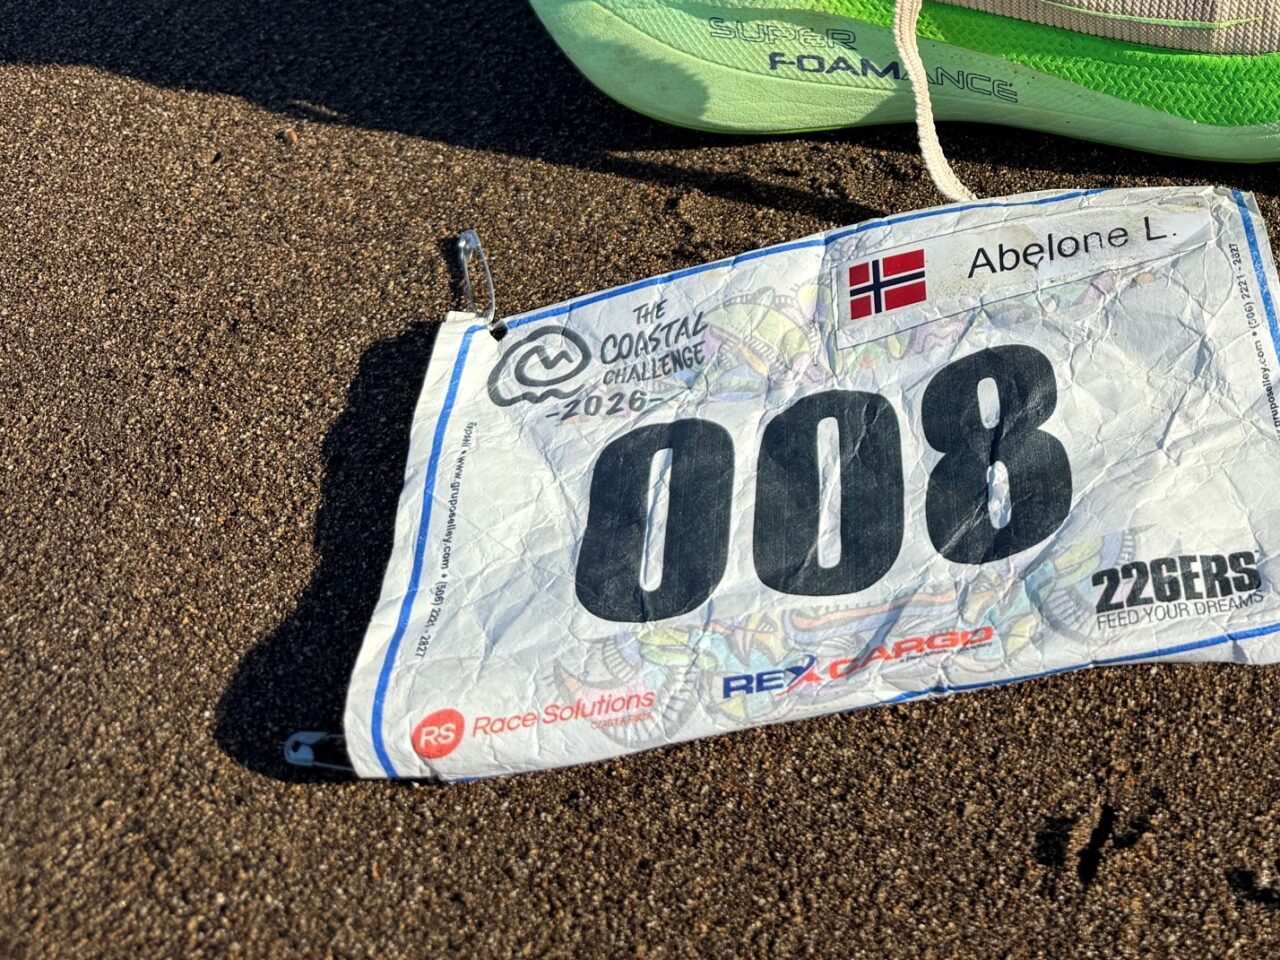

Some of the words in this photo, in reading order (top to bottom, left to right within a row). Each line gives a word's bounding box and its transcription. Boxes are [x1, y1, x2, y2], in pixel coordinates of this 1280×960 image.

[708, 16, 857, 51] SUPER
[967, 226, 1129, 279] Abelone
[1143, 215, 1177, 243] L.
[1236, 273, 1251, 299] 2221
[632, 298, 669, 325] THE
[600, 311, 708, 364] COASTAL
[602, 340, 706, 385] CHALLENGE
[574, 343, 1073, 624] 008
[430, 581, 448, 606] (506)
[1096, 608, 1139, 630] FEED
[1143, 601, 1191, 624] YOUR
[1194, 589, 1264, 616] DREAMS
[415, 634, 431, 658] 2827
[828, 625, 996, 681] CARGO
[471, 711, 538, 738] Race
[542, 690, 657, 725] Solutions
[419, 722, 457, 748] RS
